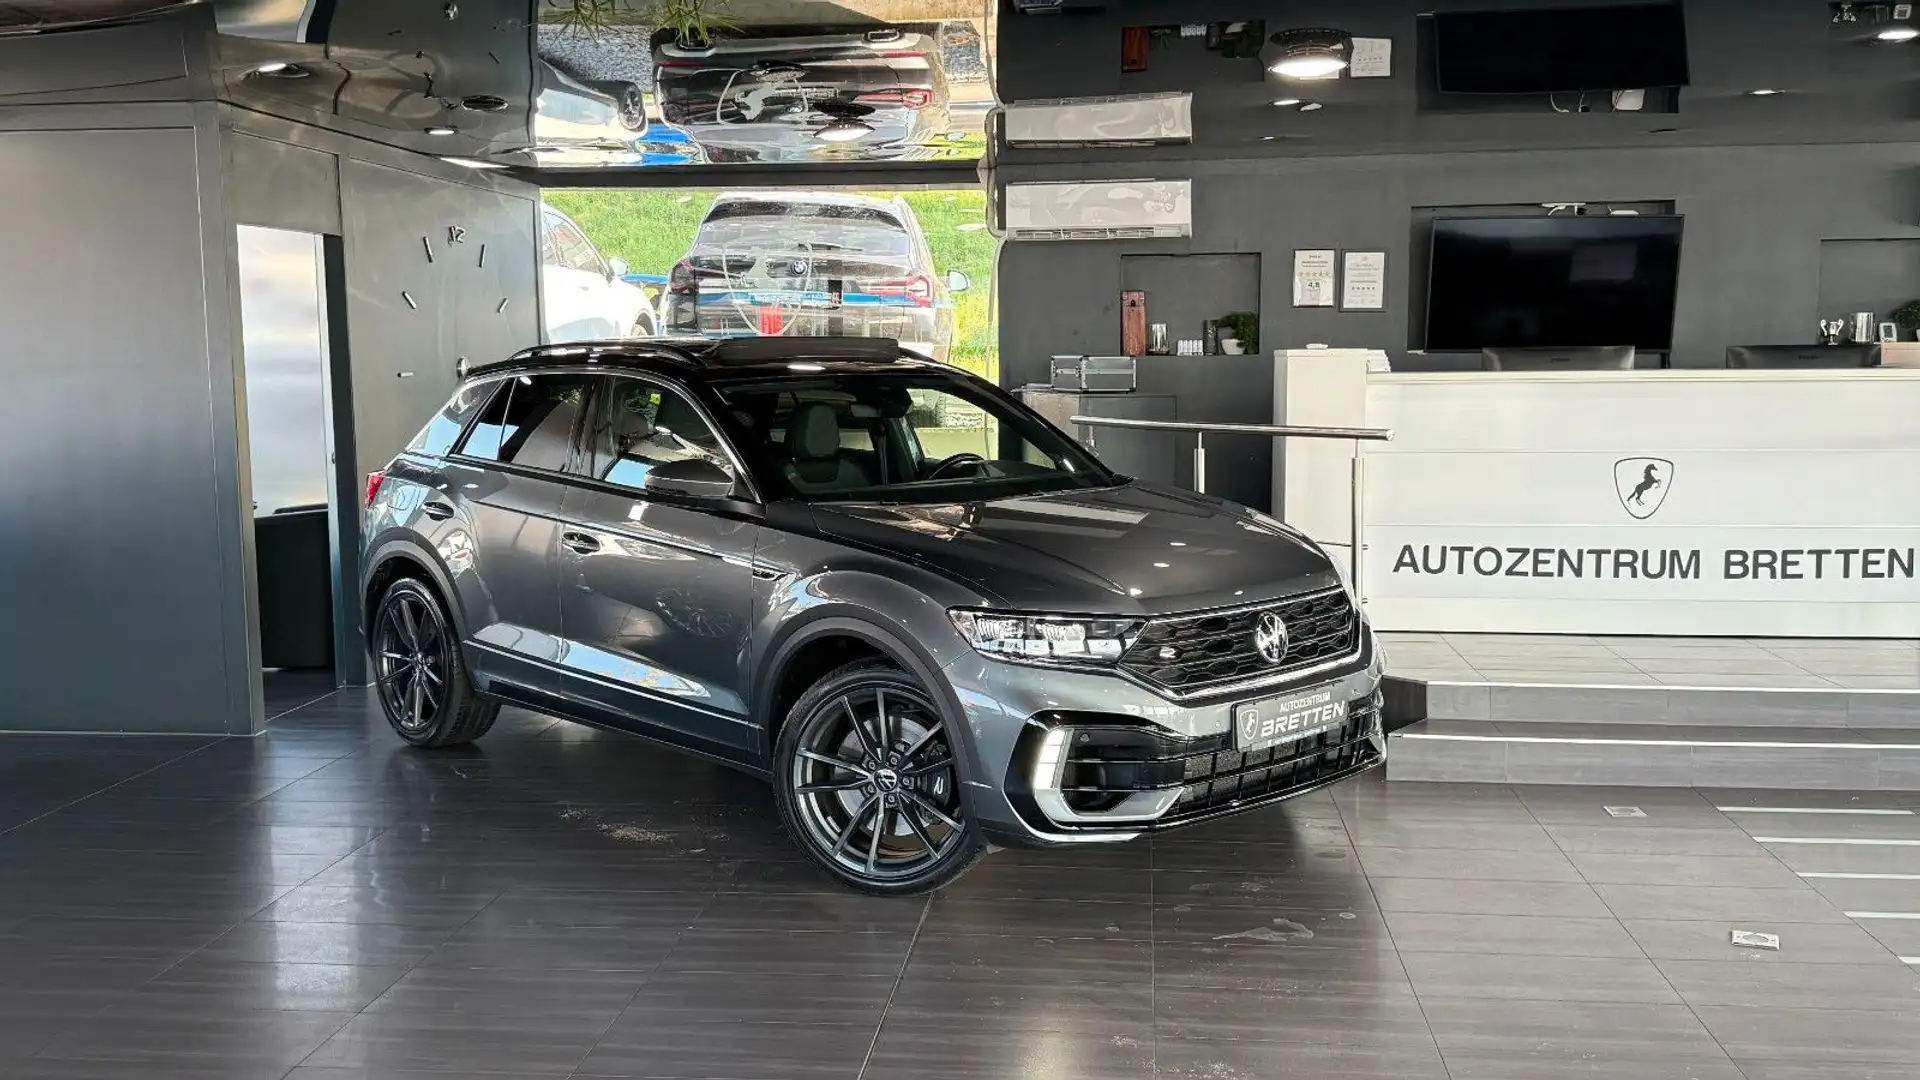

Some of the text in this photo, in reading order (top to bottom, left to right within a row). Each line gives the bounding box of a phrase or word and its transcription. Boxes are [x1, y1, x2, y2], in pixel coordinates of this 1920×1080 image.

[448, 225, 466, 244] 12
[1393, 544, 1915, 580] AUTOZENTRUM BRETTEN
[1279, 691, 1331, 713] AUTOZENTRUM
[1260, 700, 1346, 738] BRETTEN
